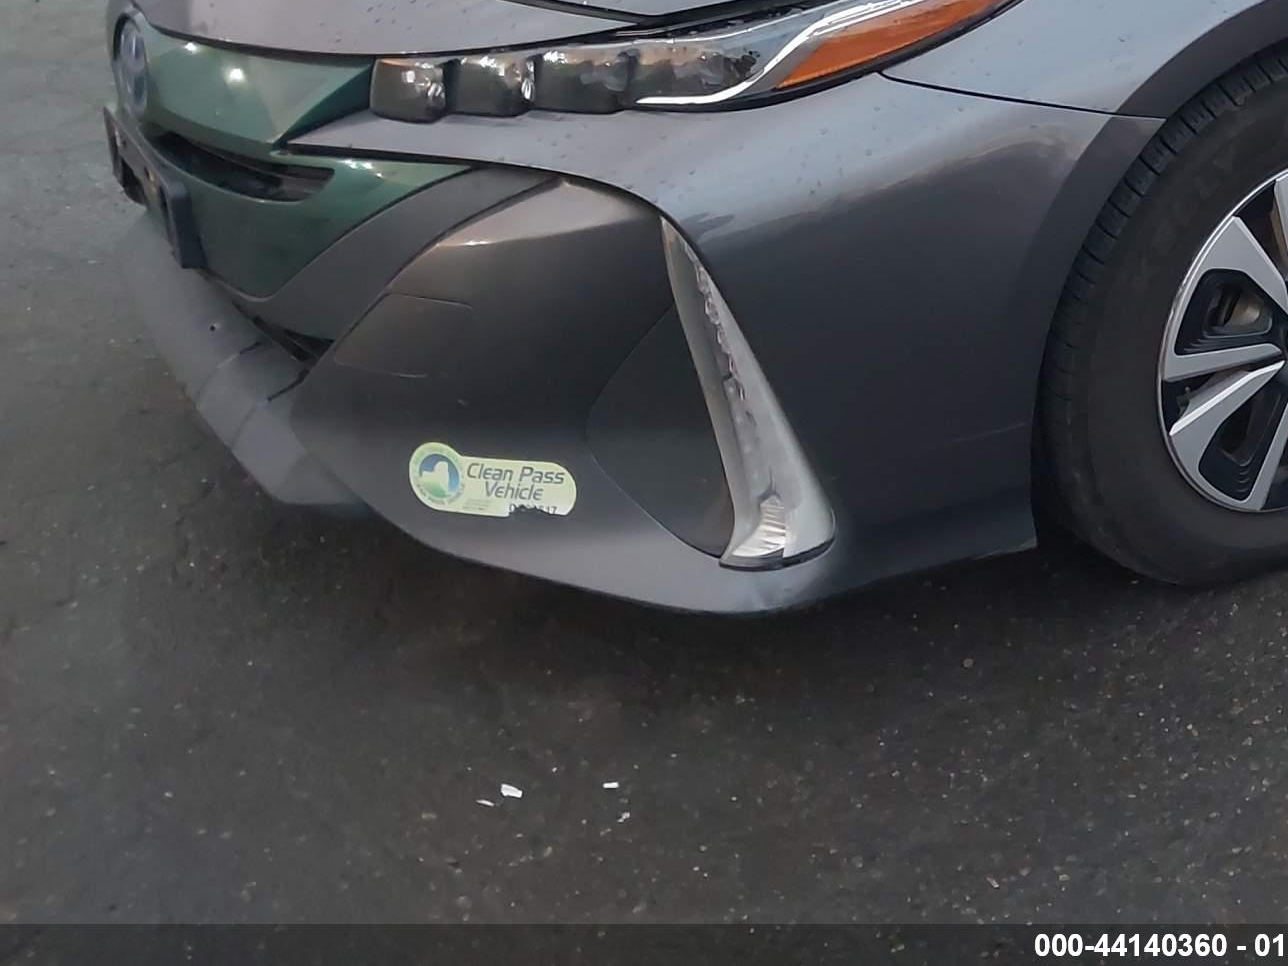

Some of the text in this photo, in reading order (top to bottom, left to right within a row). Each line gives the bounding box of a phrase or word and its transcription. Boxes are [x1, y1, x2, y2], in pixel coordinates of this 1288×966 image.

[466, 463, 566, 484] Clean Pass
[485, 481, 544, 501] Vehicle
